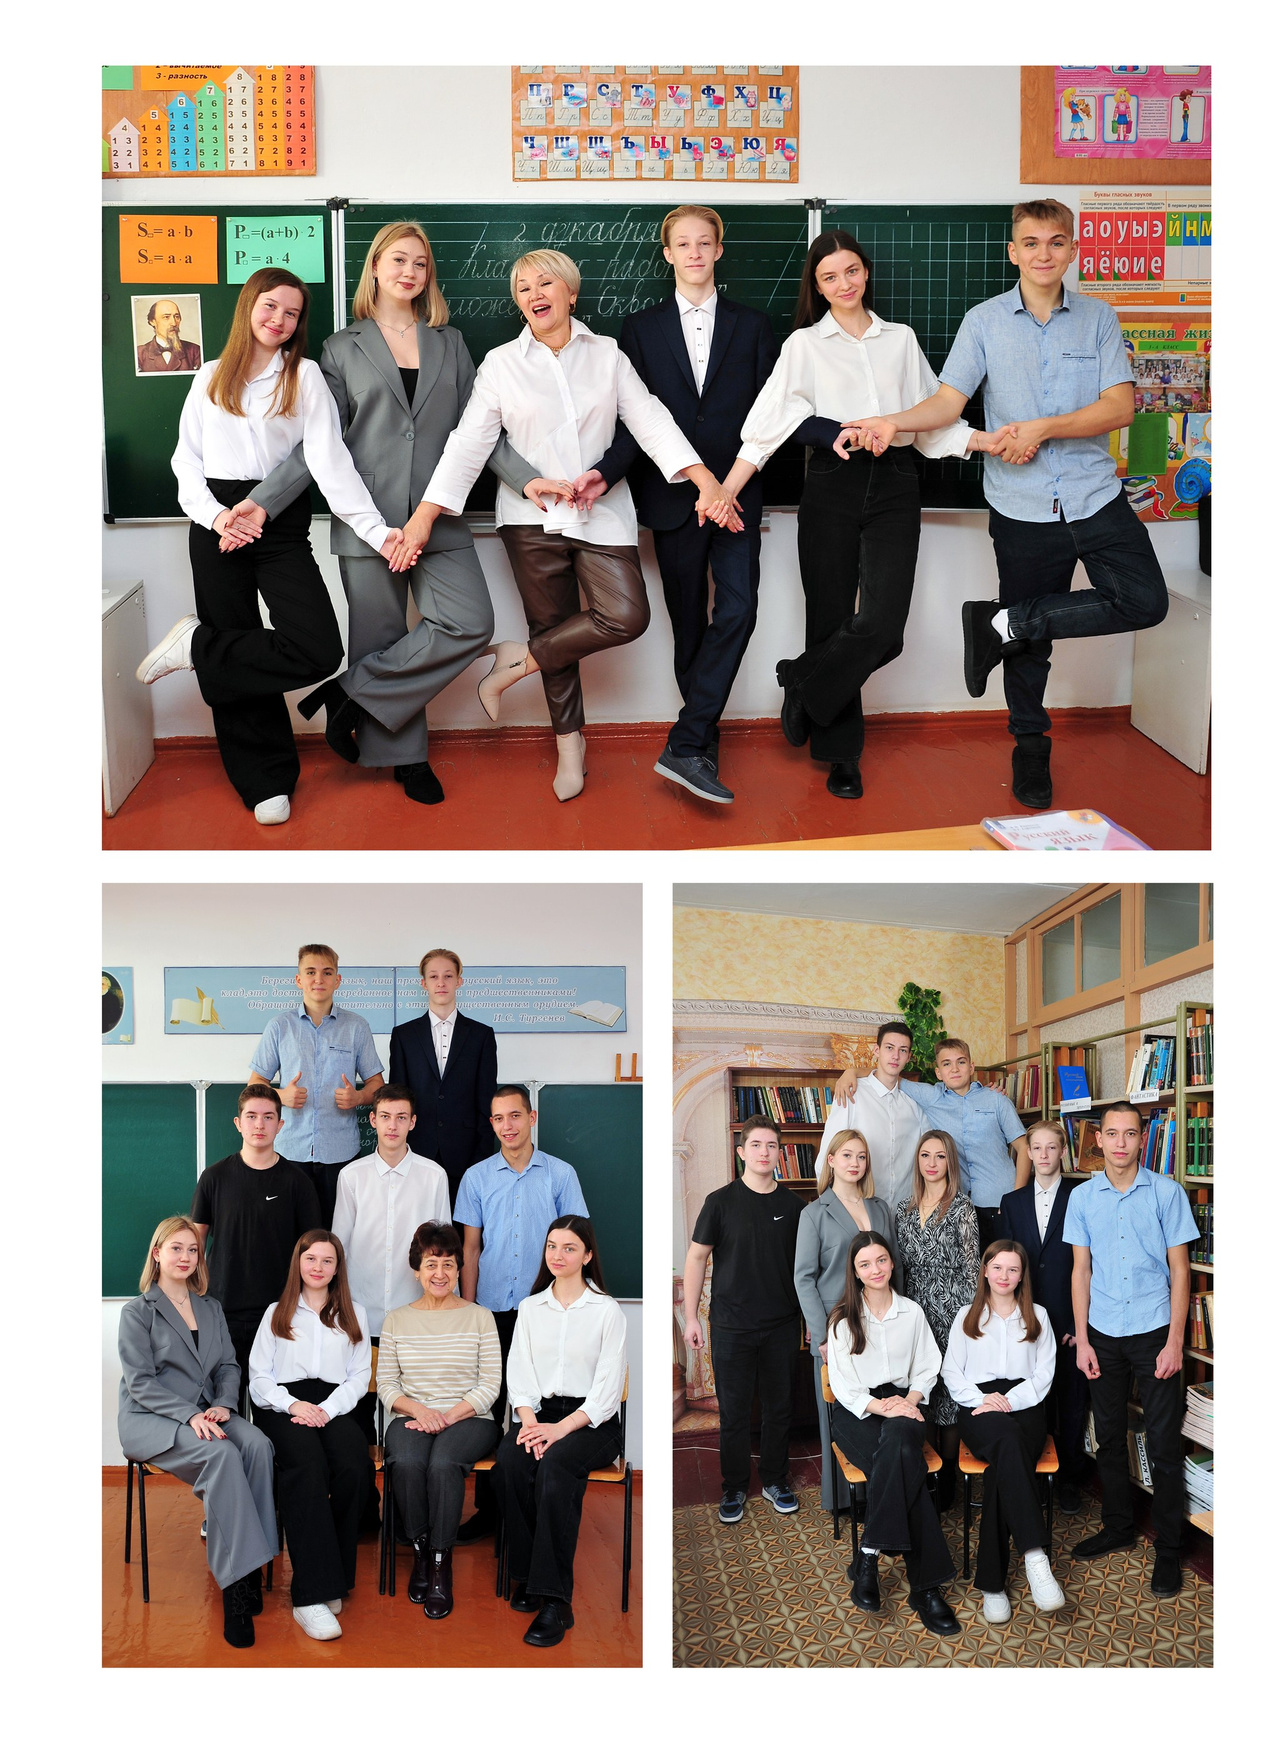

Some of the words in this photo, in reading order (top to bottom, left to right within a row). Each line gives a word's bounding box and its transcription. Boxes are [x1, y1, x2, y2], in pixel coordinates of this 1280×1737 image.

[529, 84, 542, 96] П
[563, 84, 574, 97] Р
[597, 84, 610, 96] С
[632, 84, 643, 98] Т
[668, 85, 680, 100] У
[701, 85, 716, 98] Ф
[734, 86, 747, 99] Х
[768, 86, 782, 100] Ц
[178, 98, 185, 106] 6
[151, 111, 158, 119] 5
[524, 136, 535, 148] Ч
[554, 136, 570, 148] Ш
[621, 136, 634, 149] Ъ
[650, 136, 666, 148] Ы
[681, 137, 692, 150] Ь
[710, 138, 722, 149] Э
[743, 138, 760, 150] Ю
[775, 138, 786, 150] Я
[167, 226, 175, 238] a
[184, 225, 193, 238] b
[307, 226, 315, 238] 2
[513, 223, 527, 242] 2
[1083, 220, 1094, 238] а
[1099, 220, 1111, 238] о
[1117, 220, 1129, 244] у
[1132, 220, 1148, 238] ы
[1152, 220, 1163, 238] э
[1169, 214, 1180, 237] й
[1186, 220, 1197, 237] н
[168, 253, 176, 264] a
[184, 253, 192, 264] a
[266, 254, 273, 264] a
[282, 252, 290, 264] 4
[1083, 255, 1094, 273] я
[1099, 250, 1110, 273] ё
[1115, 255, 1129, 273] ю
[1134, 255, 1145, 273] и
[1151, 256, 1162, 273] е
[261, 977, 296, 986] Береги
[506, 976, 534, 985] язык,
[272, 989, 303, 997] досто
[466, 988, 576, 997] предшественниками!
[533, 1000, 578, 1009] орудием.
[493, 1014, 515, 1022] И.С.
[519, 1014, 566, 1023] Тургенев
